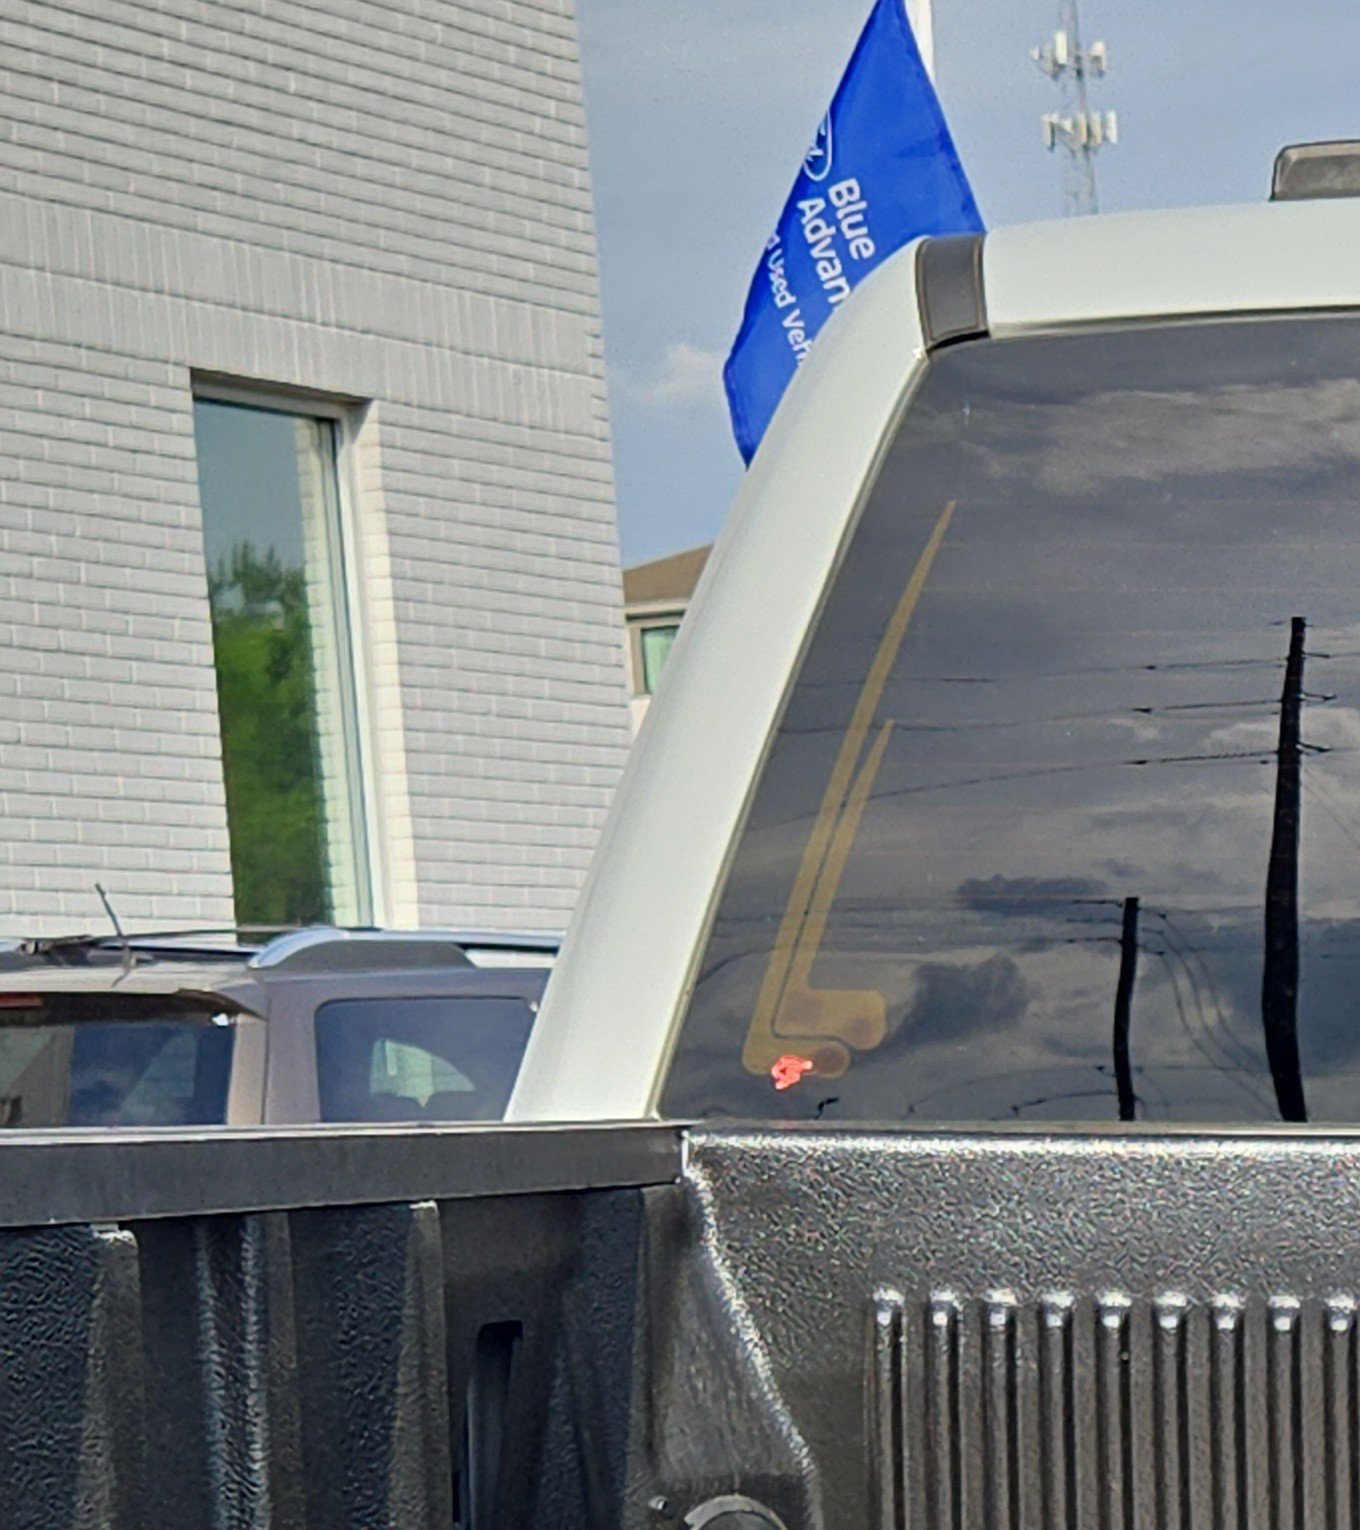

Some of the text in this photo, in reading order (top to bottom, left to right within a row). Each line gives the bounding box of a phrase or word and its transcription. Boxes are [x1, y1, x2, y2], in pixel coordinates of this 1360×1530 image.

[828, 178, 875, 260] Blue
[767, 249, 797, 309] Used
[782, 308, 813, 365] Veh
